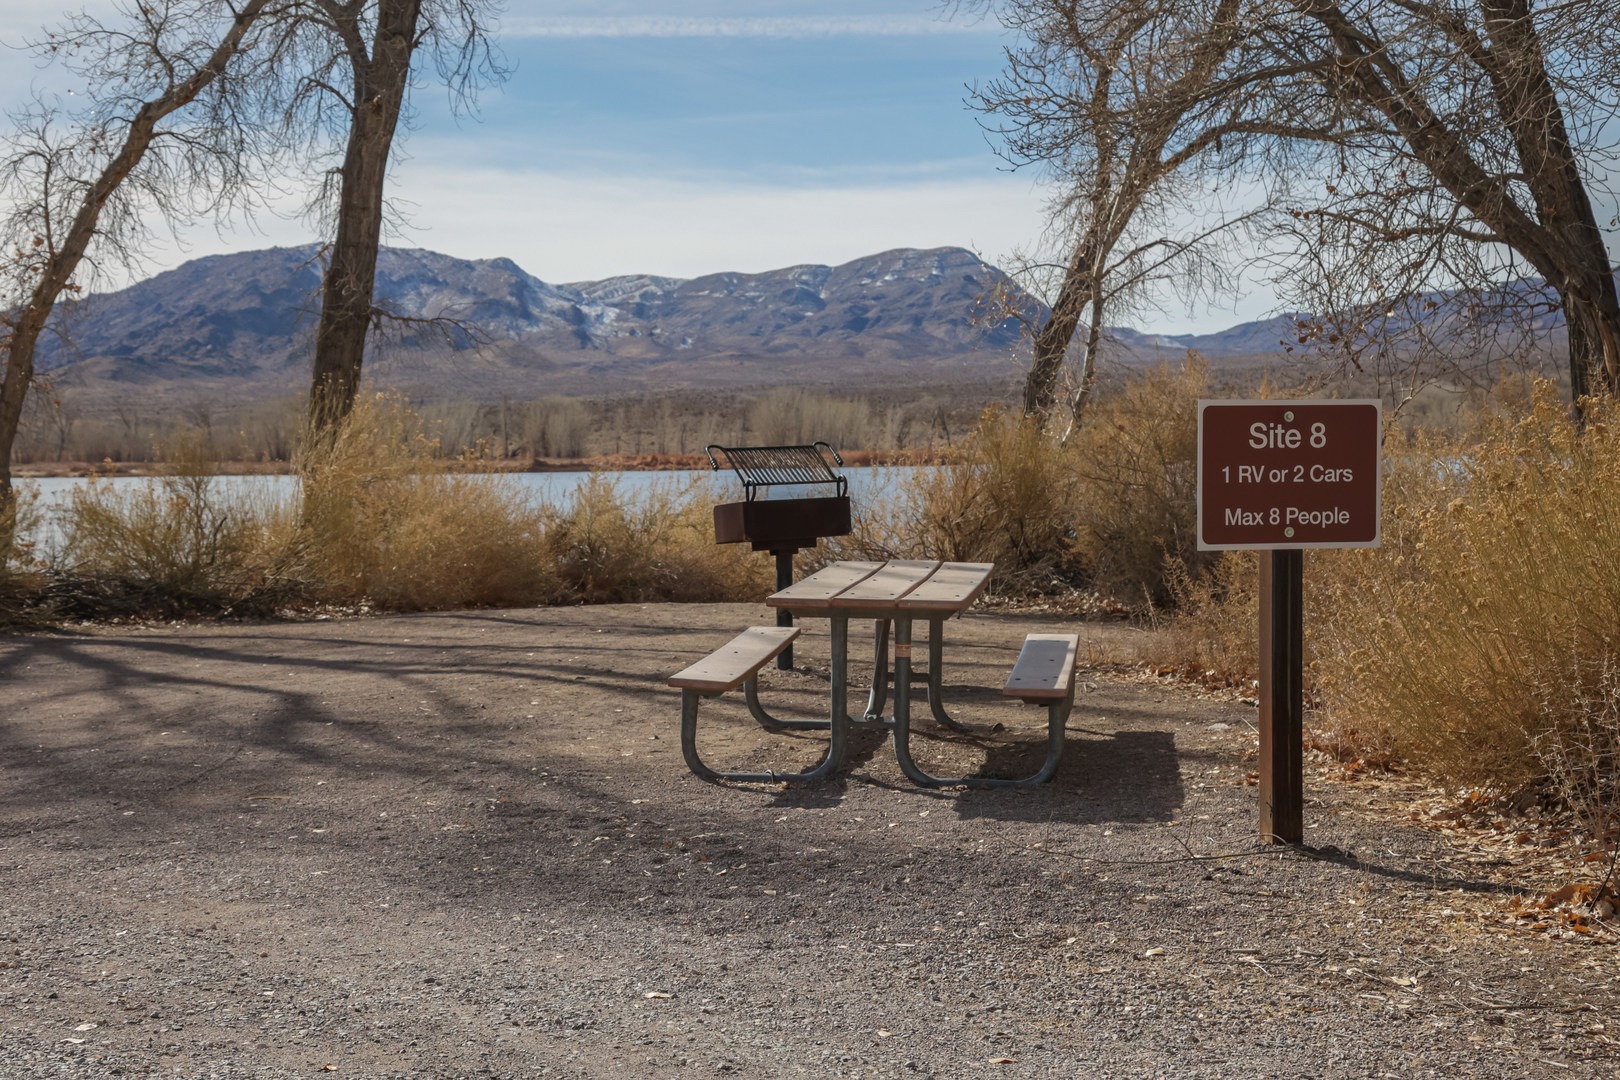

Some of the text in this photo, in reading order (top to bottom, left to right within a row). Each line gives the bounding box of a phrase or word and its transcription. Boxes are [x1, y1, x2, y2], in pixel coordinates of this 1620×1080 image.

[1248, 422, 1327, 449] Site 8
[1221, 464, 1353, 483] 1 RV or 2 Cars
[1224, 506, 1350, 528] Max 8 People
